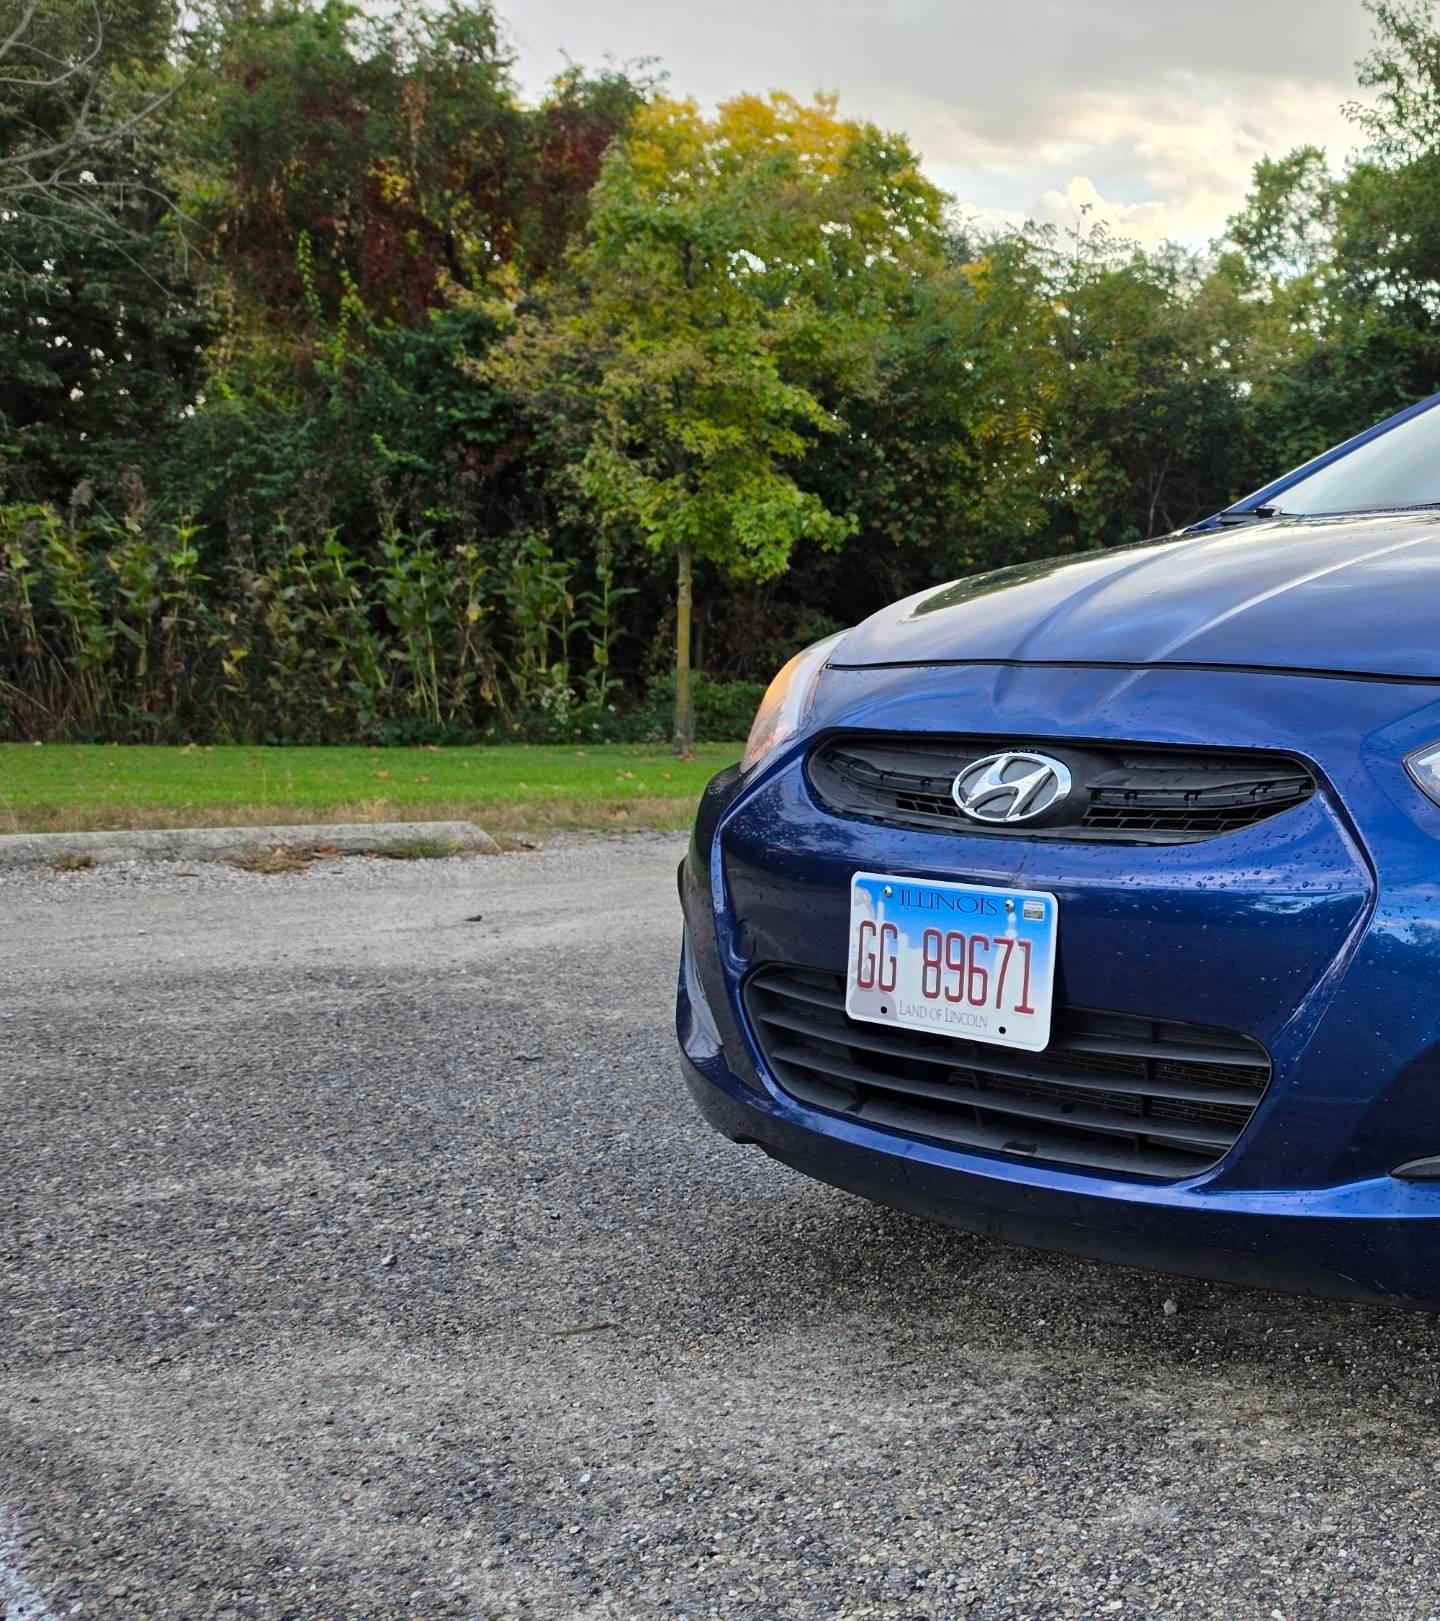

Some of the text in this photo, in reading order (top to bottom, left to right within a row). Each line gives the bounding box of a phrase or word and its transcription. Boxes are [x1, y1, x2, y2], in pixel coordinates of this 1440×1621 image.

[900, 889, 999, 916] ILLINOIS
[856, 920, 1036, 1015] GG 89671
[898, 1000, 989, 1028] LAND OF LINCOLN
